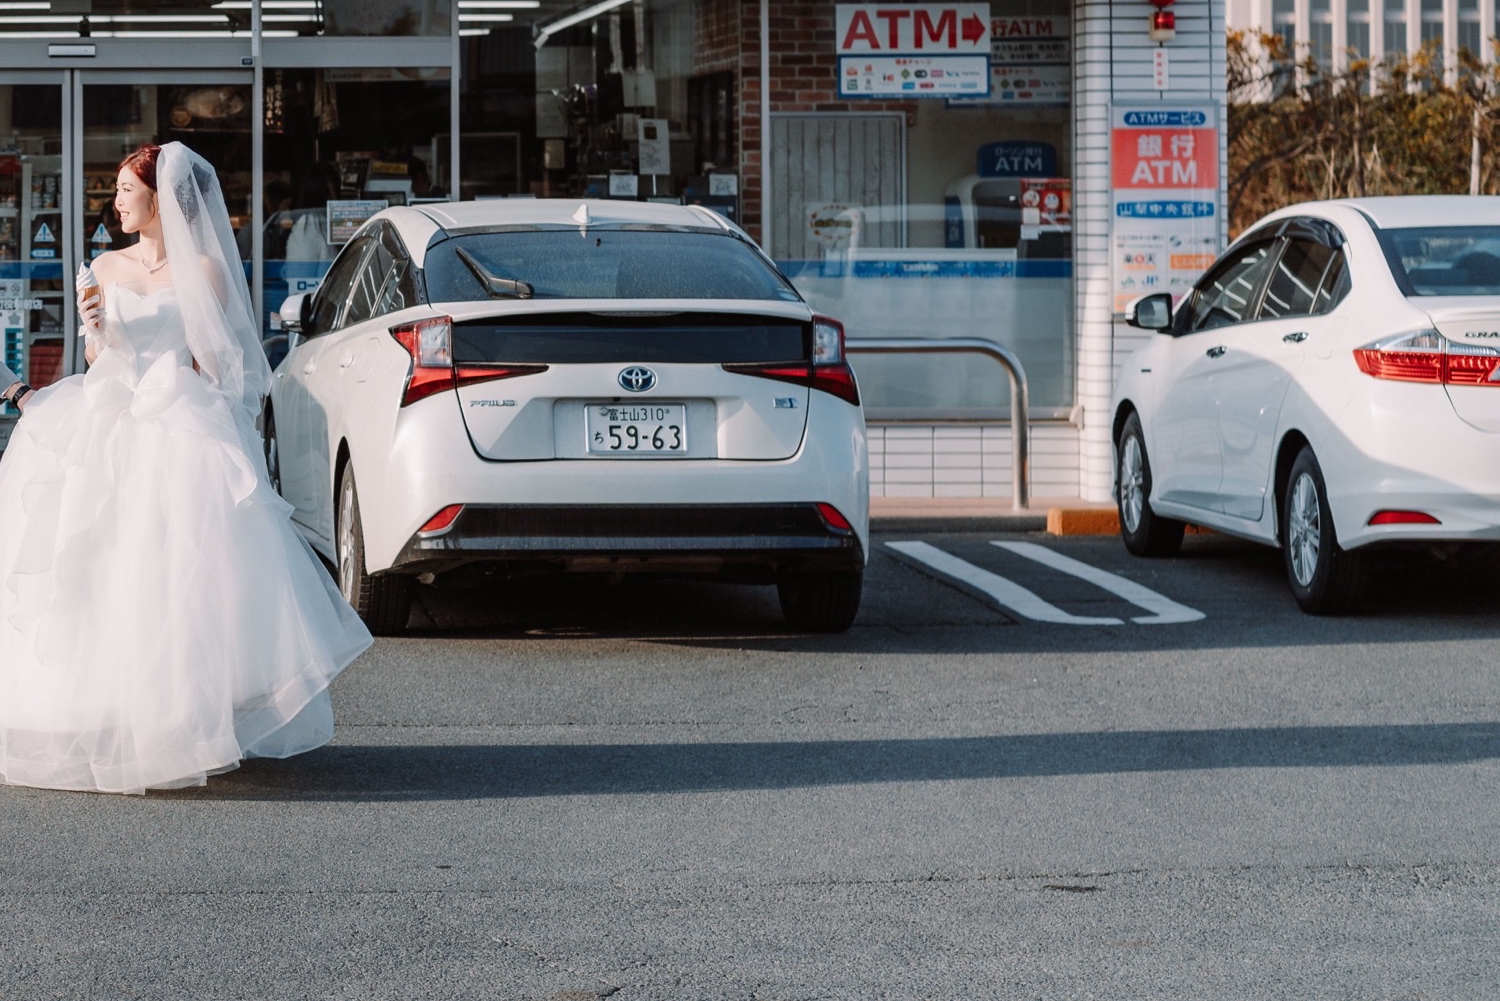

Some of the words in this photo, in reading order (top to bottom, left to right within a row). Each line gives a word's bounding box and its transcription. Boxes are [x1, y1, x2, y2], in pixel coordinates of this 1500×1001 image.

[842, 9, 957, 49] ATM
[1129, 112, 1202, 124] ATMサービス
[1137, 135, 1195, 157] 銀行
[995, 157, 1042, 172] ATM
[1131, 160, 1197, 184] ATM
[470, 399, 516, 407] PRIUS
[594, 430, 605, 444] ち
[609, 425, 681, 450] 59-63
